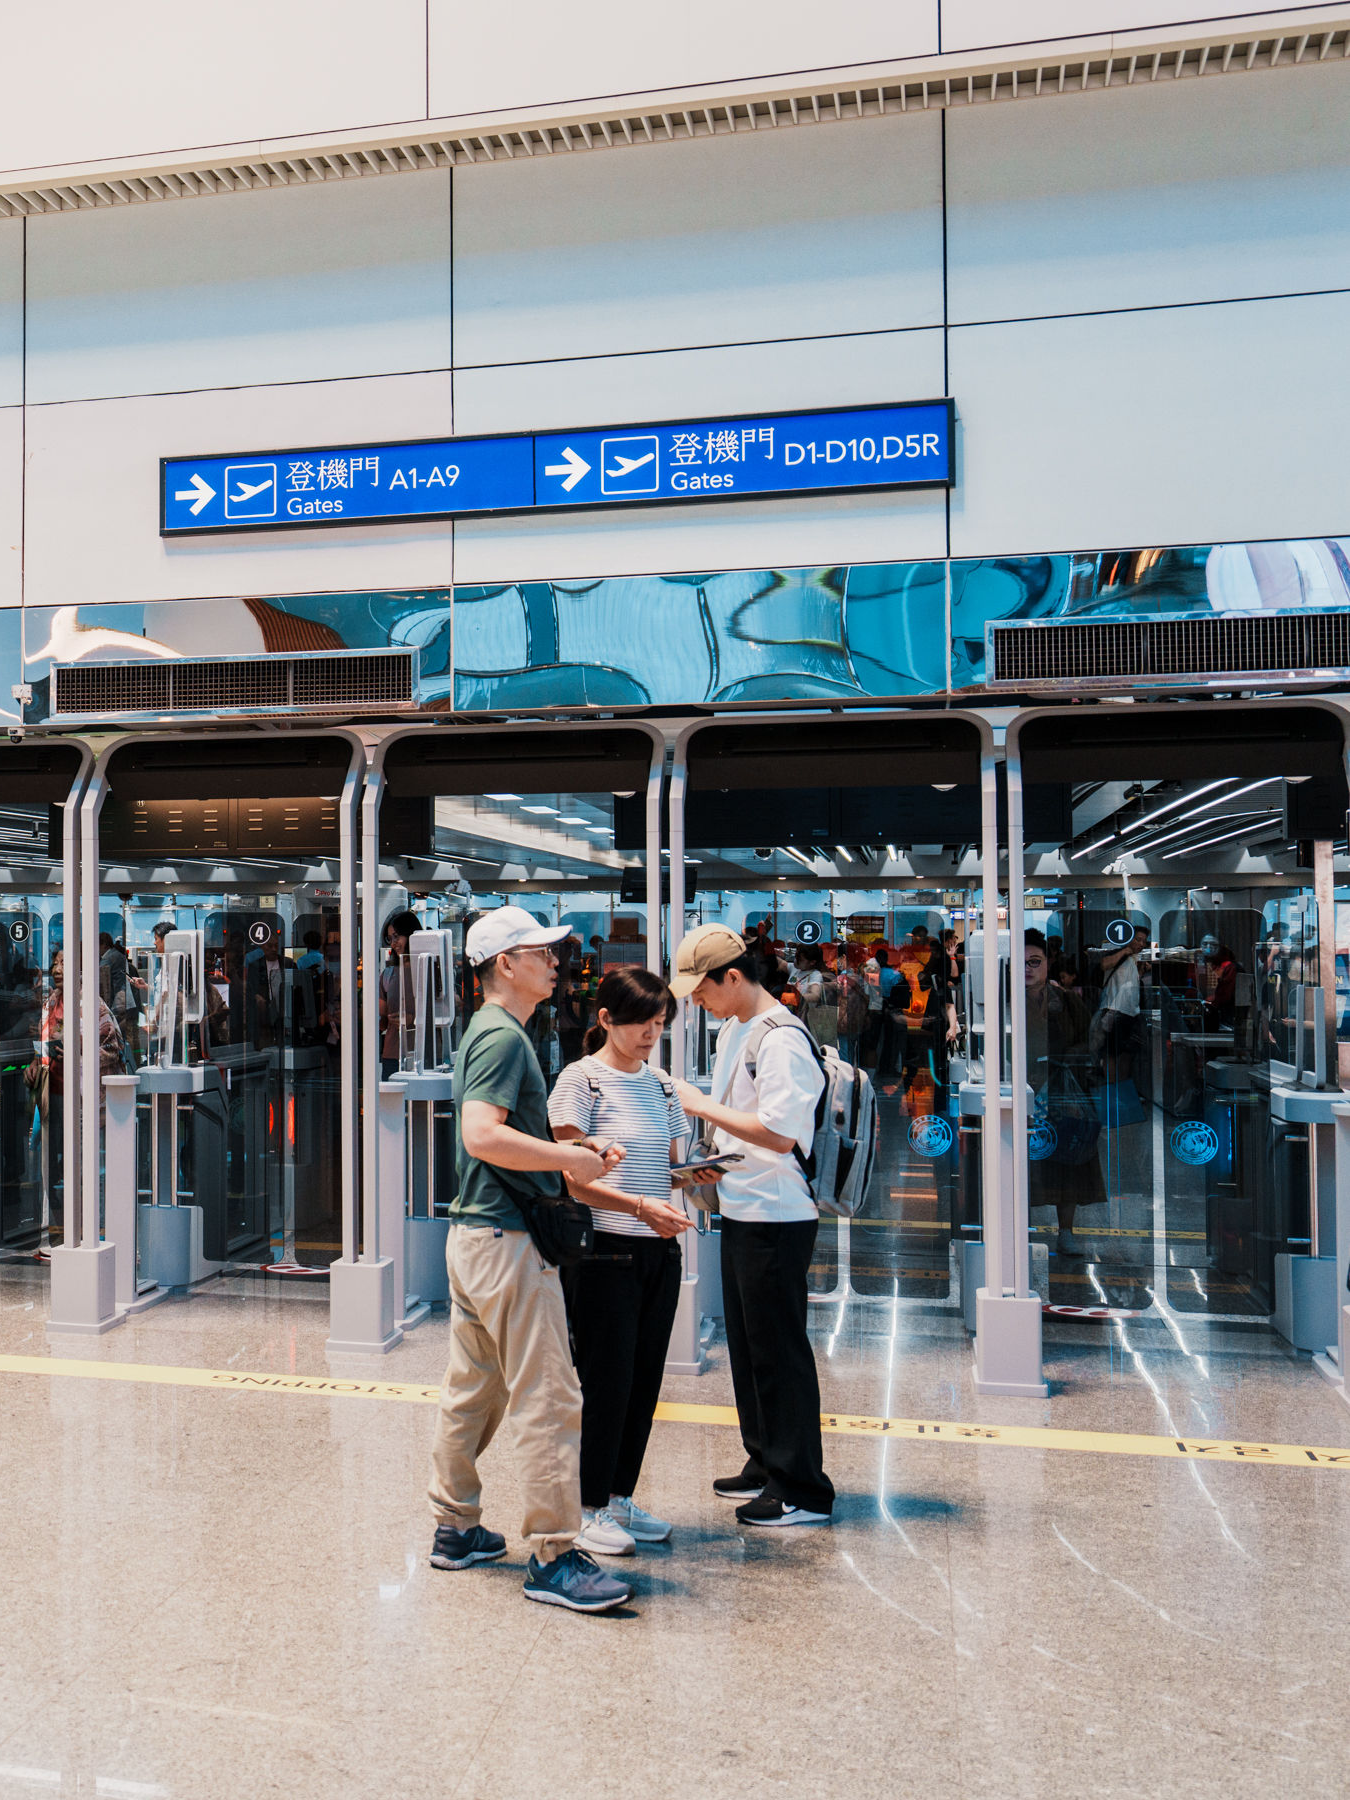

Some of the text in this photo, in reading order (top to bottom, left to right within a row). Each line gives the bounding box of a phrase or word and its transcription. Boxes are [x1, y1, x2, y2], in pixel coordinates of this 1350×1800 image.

[669, 427, 940, 466] 登機門 D1-D10,D5R
[286, 456, 460, 492] 登機門 A1-A9
[670, 469, 734, 490] Gates
[287, 497, 343, 516] Gates
[212, 1374, 403, 1395] STOPPING
